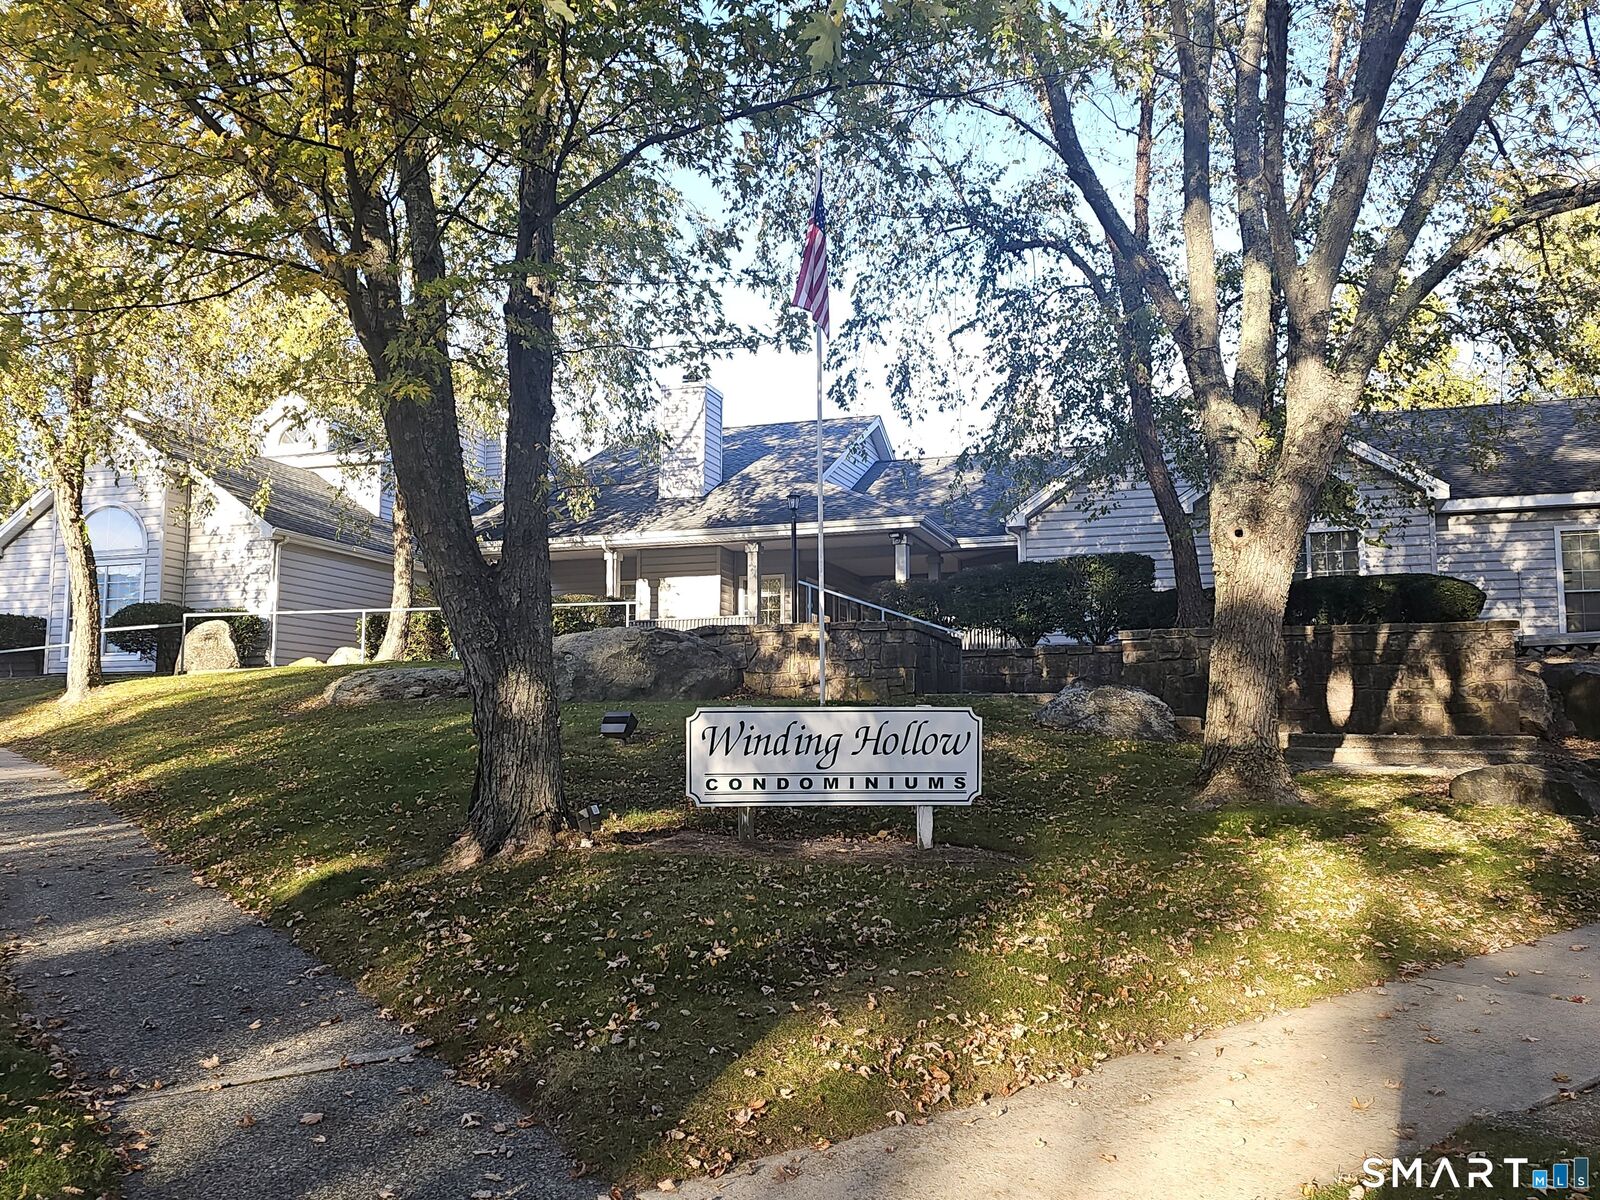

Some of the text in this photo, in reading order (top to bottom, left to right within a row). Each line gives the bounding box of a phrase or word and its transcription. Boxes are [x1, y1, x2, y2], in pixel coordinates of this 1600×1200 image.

[701, 719, 971, 770] Winding Hollow
[705, 776, 966, 791] CONDOMINIUMS
